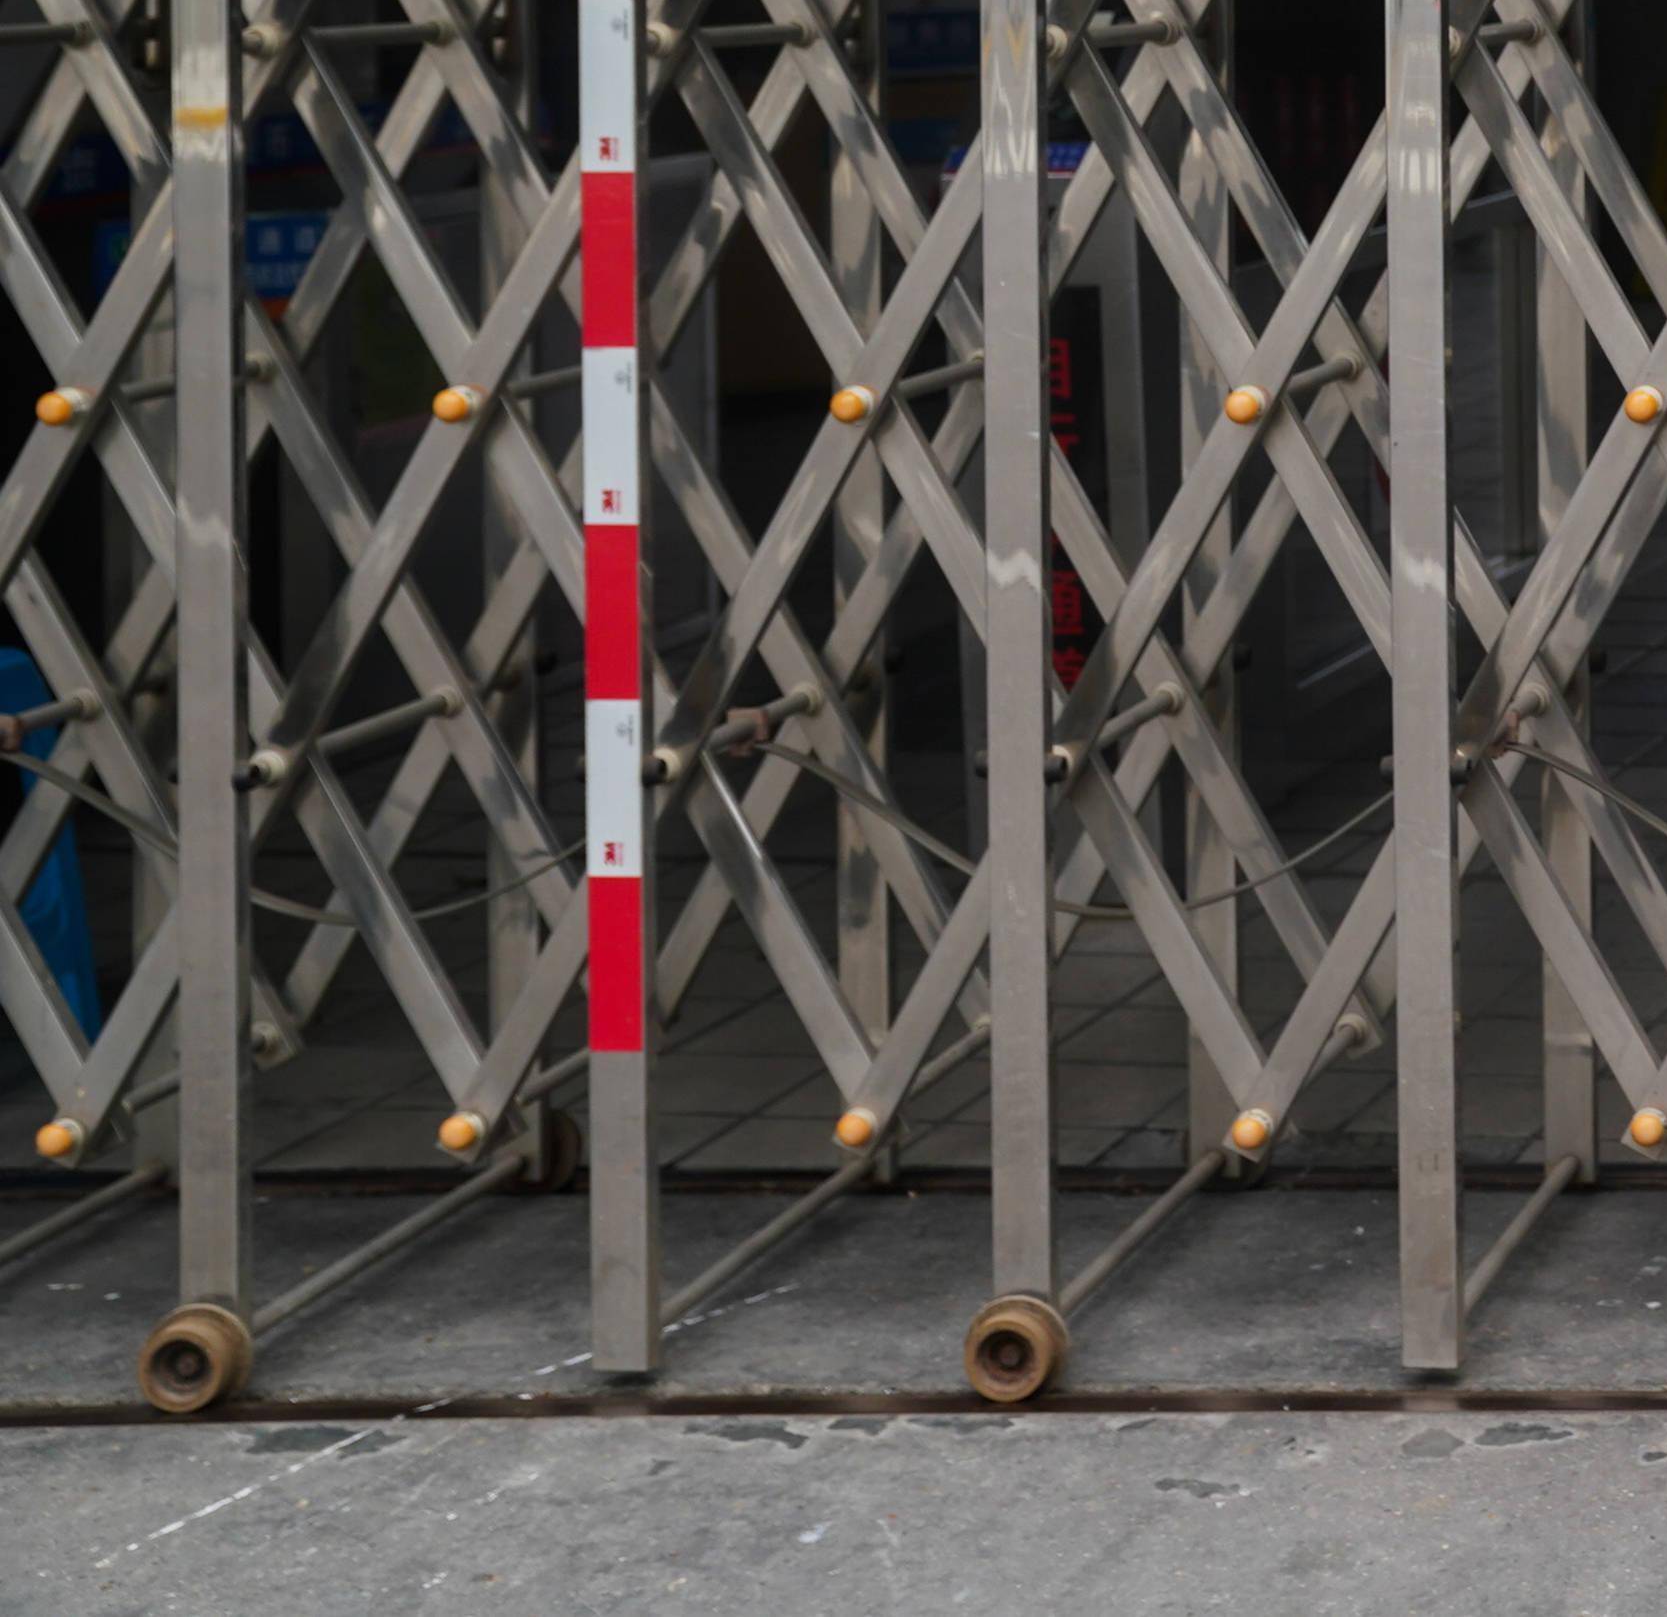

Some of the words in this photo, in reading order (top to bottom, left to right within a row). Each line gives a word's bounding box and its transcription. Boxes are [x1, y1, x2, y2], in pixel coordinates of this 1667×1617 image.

[601, 138, 611, 159] 3M
[604, 491, 616, 511] 3M
[605, 843, 616, 864] 3M
